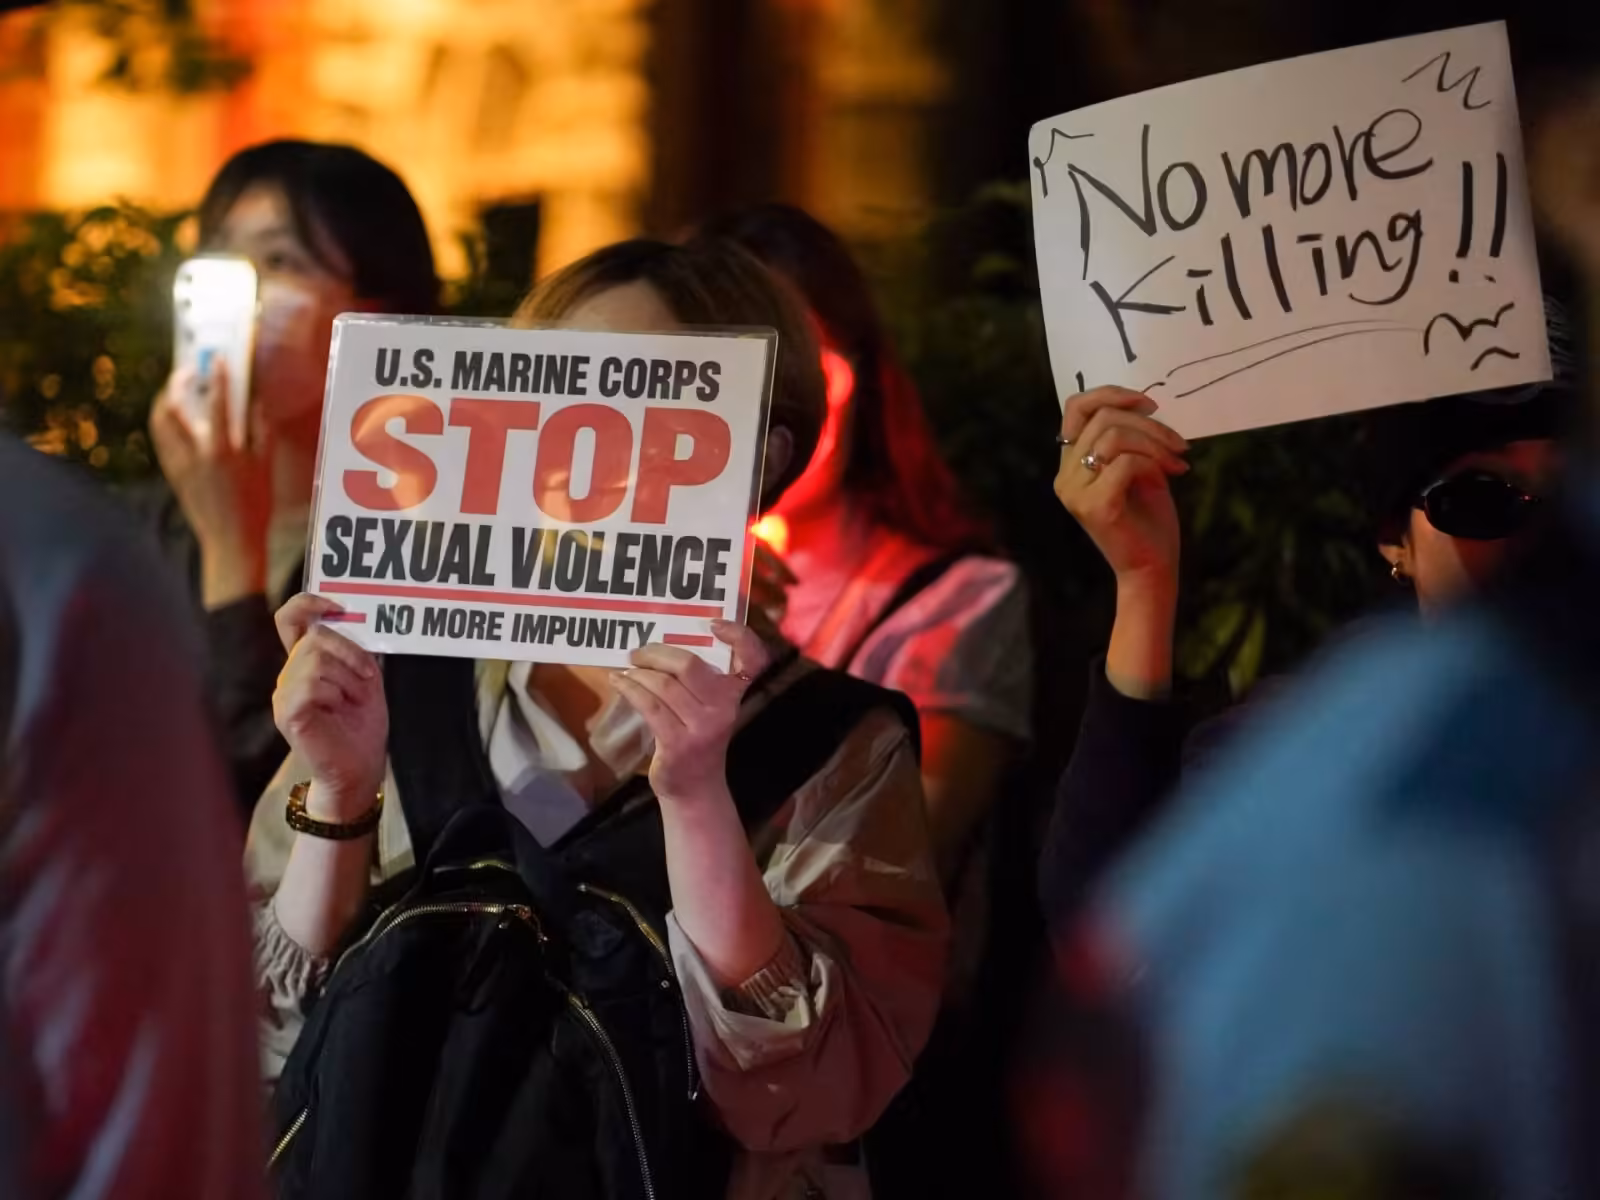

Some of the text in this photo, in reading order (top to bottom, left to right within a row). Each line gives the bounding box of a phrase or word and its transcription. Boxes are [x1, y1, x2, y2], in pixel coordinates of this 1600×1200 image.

[1068, 109, 1433, 280] No more
[375, 348, 721, 402] U.S. MARINE CORPS
[342, 394, 731, 525] STOP
[321, 515, 731, 602] SEXUAL VIOLENCE
[375, 604, 656, 650] NO MORE IMPUNITY
